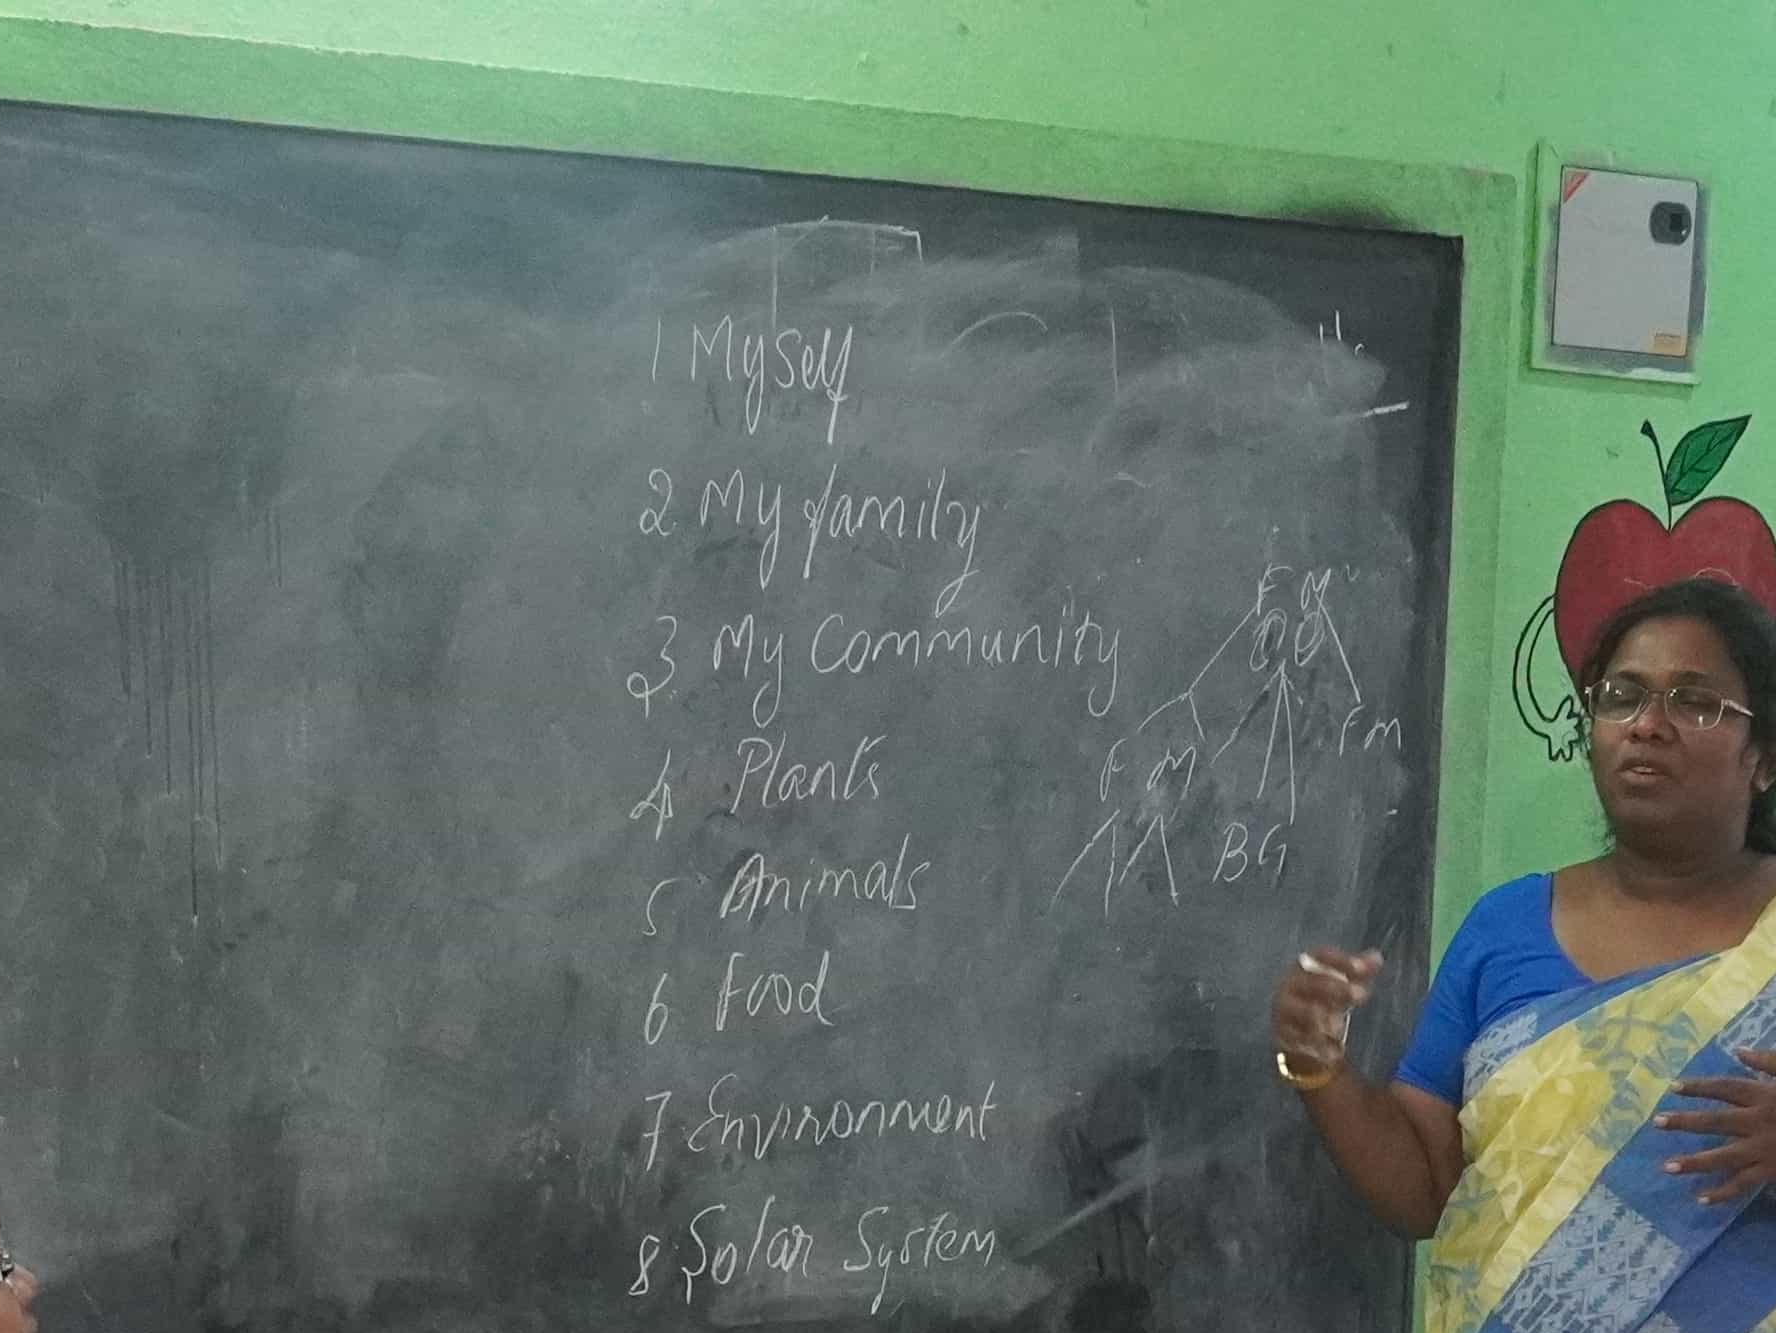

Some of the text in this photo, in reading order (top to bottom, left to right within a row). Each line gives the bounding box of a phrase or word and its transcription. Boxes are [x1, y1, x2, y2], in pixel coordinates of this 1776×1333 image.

[638, 462, 982, 616] 2 My family
[712, 613, 784, 728] My
[809, 604, 1123, 720] Community
[729, 734, 889, 815] Plants
[718, 833, 932, 923] Animals
[641, 949, 836, 1047] 6 Food
[628, 1194, 999, 1316] 8 Solar System
